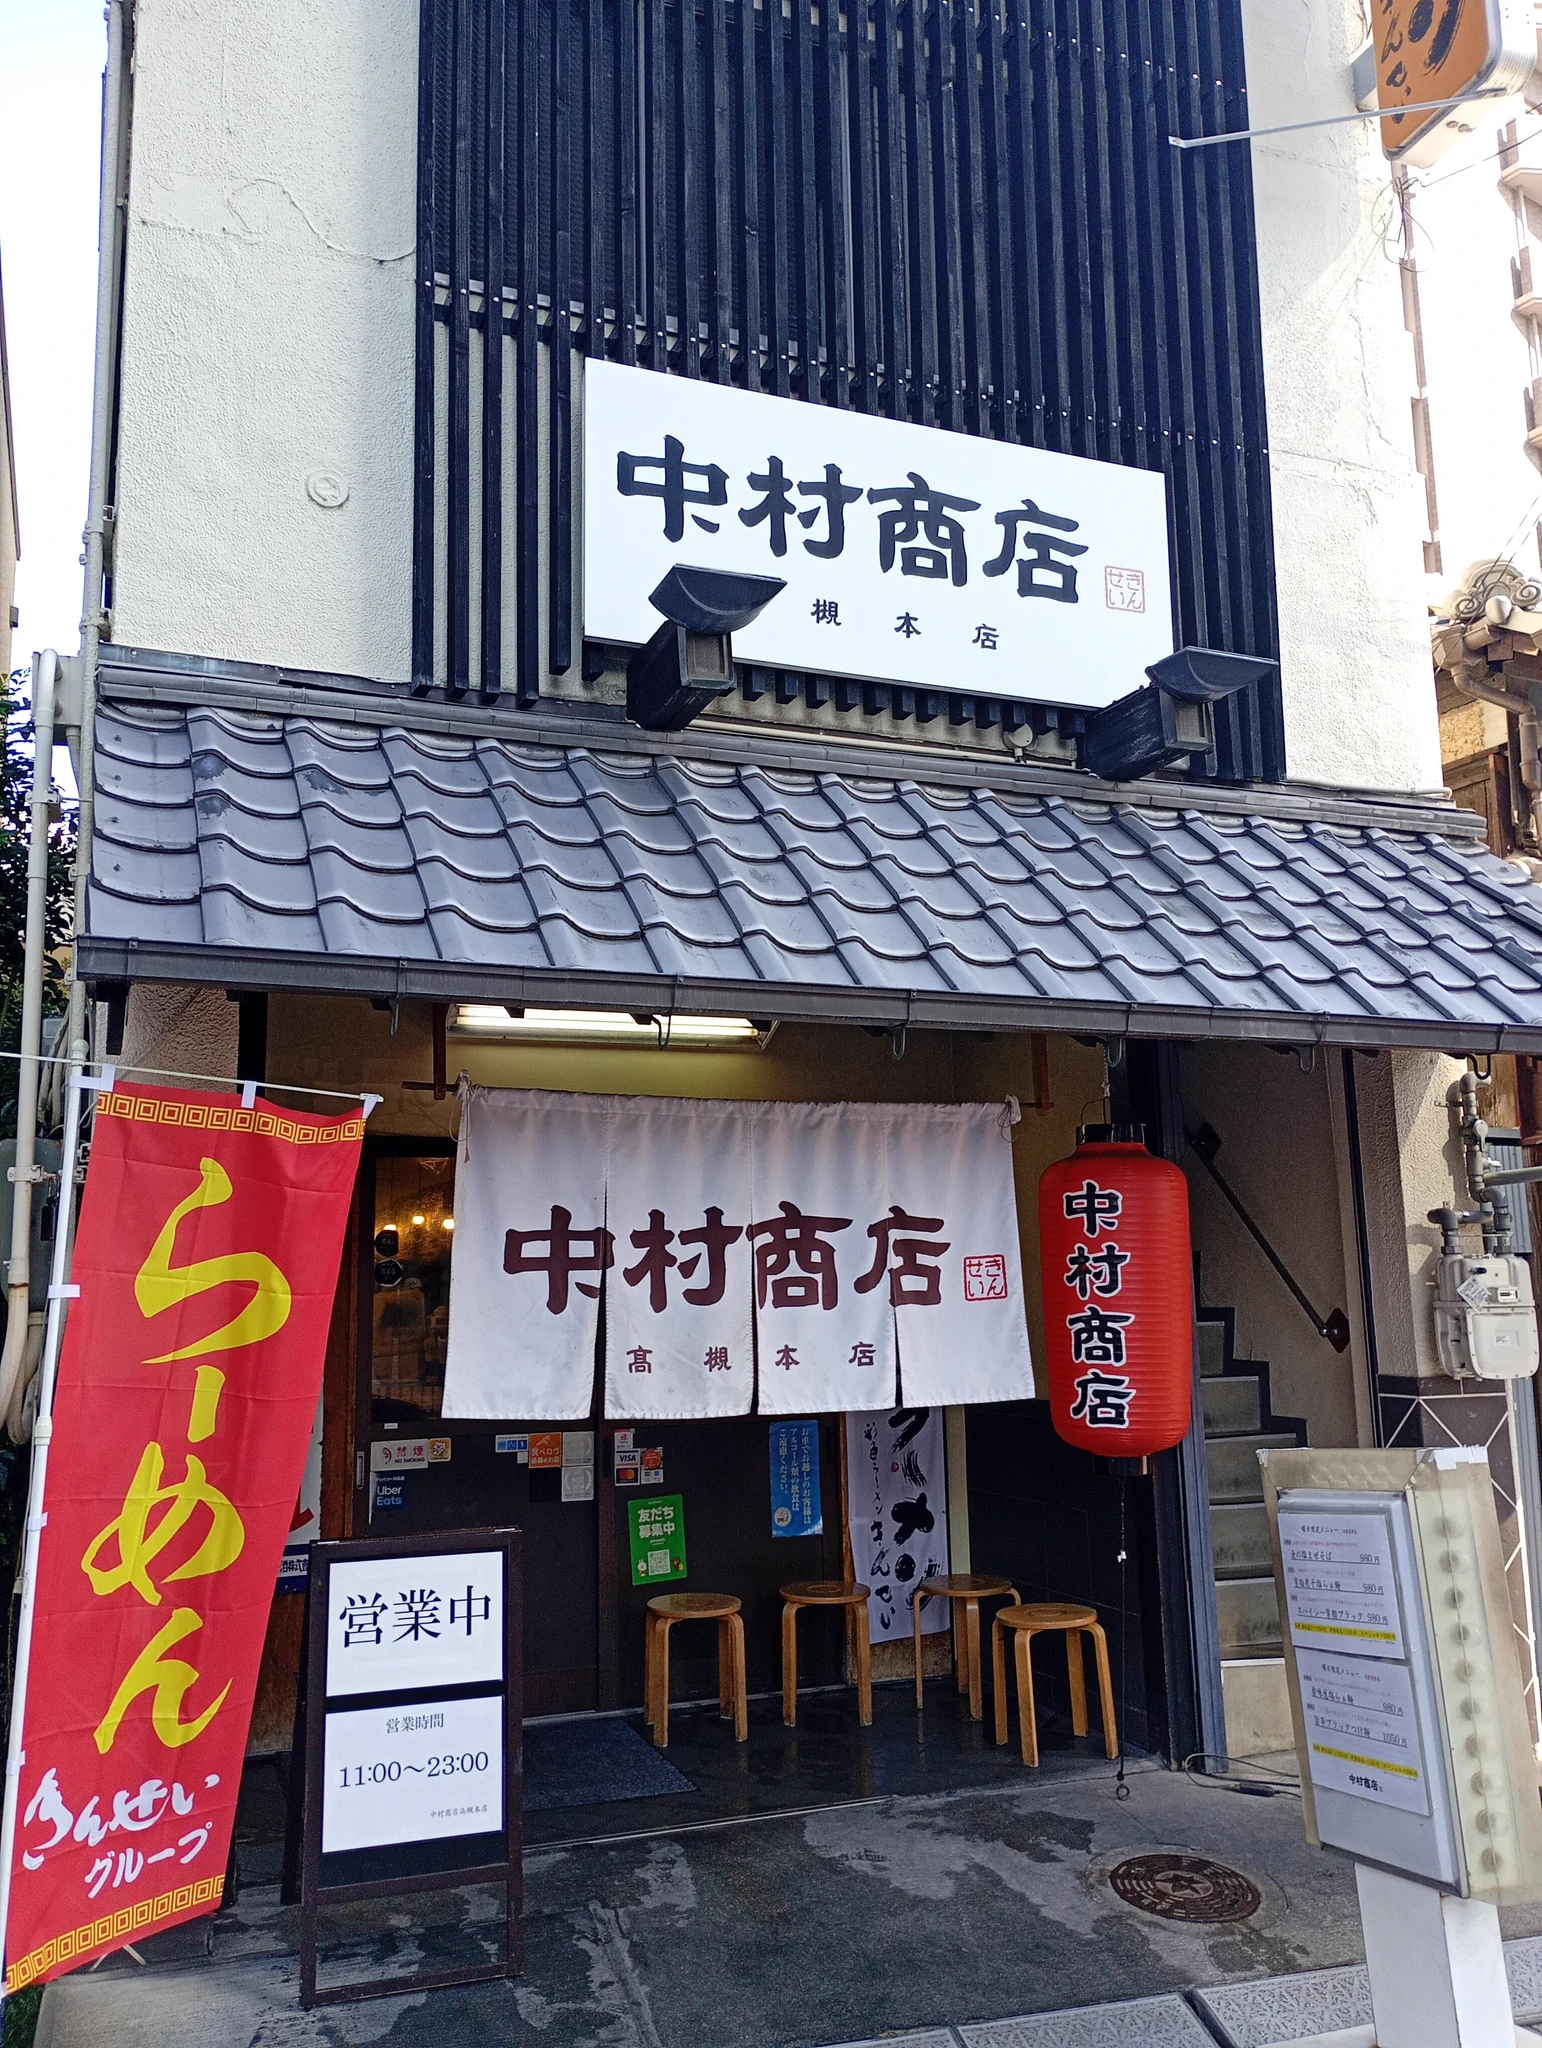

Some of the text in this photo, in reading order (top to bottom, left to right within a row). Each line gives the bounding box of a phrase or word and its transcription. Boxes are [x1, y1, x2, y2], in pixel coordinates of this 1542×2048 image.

[616, 434, 1089, 604] 中村商店
[503, 1201, 951, 1314] 中村商店
[1063, 1178, 1136, 1429] 中村商店
[81, 1156, 292, 1755] らーめん
[397, 1446, 423, 1457] 禁煙
[531, 1447, 559, 1456] 食べログ
[619, 1454, 636, 1462] VISA
[377, 1486, 402, 1495] Uber
[377, 1496, 402, 1506] Eats
[638, 1505, 674, 1523] 友だち
[639, 1521, 675, 1538] 募集中
[339, 1585, 491, 1648] 営業中
[386, 1713, 445, 1734] 営業時間
[1348, 1774, 1378, 1791] 中村商店
[84, 1821, 213, 1899] グループ
